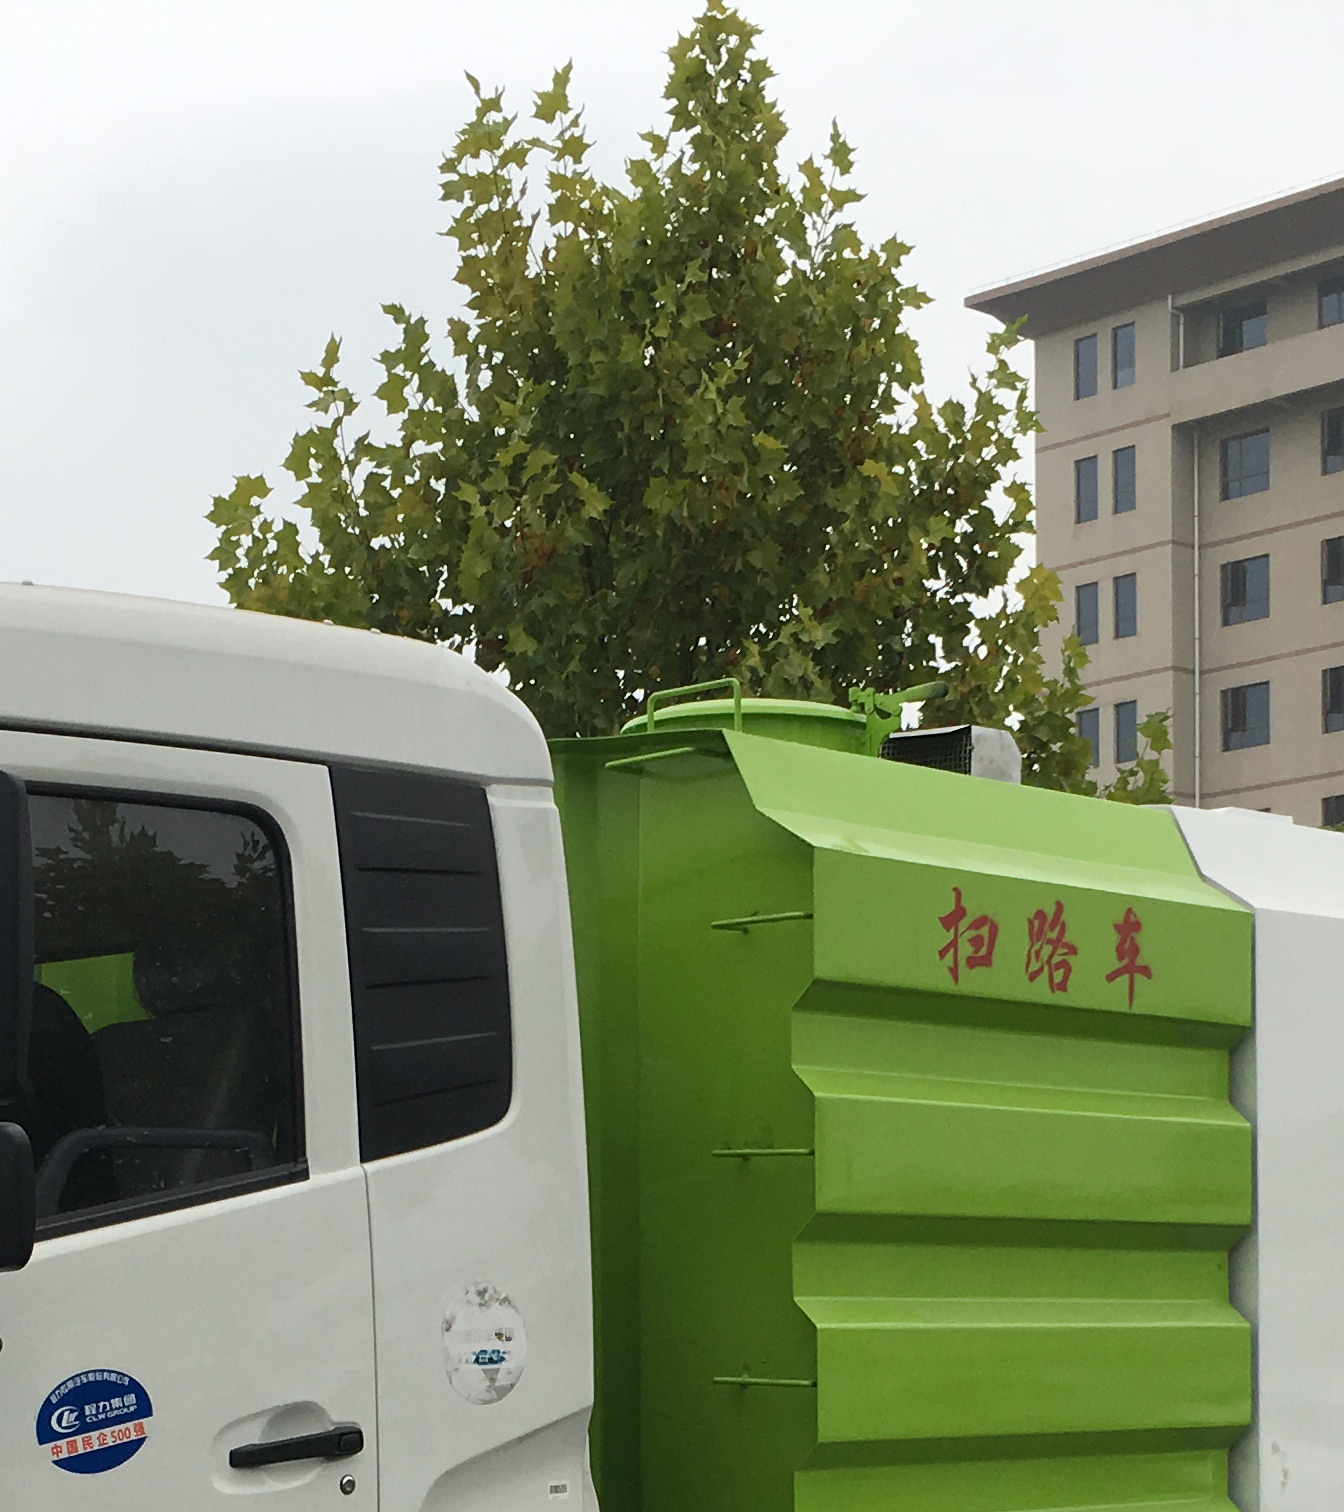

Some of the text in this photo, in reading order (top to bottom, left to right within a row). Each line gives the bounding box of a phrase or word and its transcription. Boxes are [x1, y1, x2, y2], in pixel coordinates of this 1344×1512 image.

[937, 886, 1153, 1010] 扫路车
[84, 1393, 137, 1416] 程力集团
[85, 1404, 138, 1423] CLW GROUP
[50, 1421, 146, 1459] 中国民企500强
